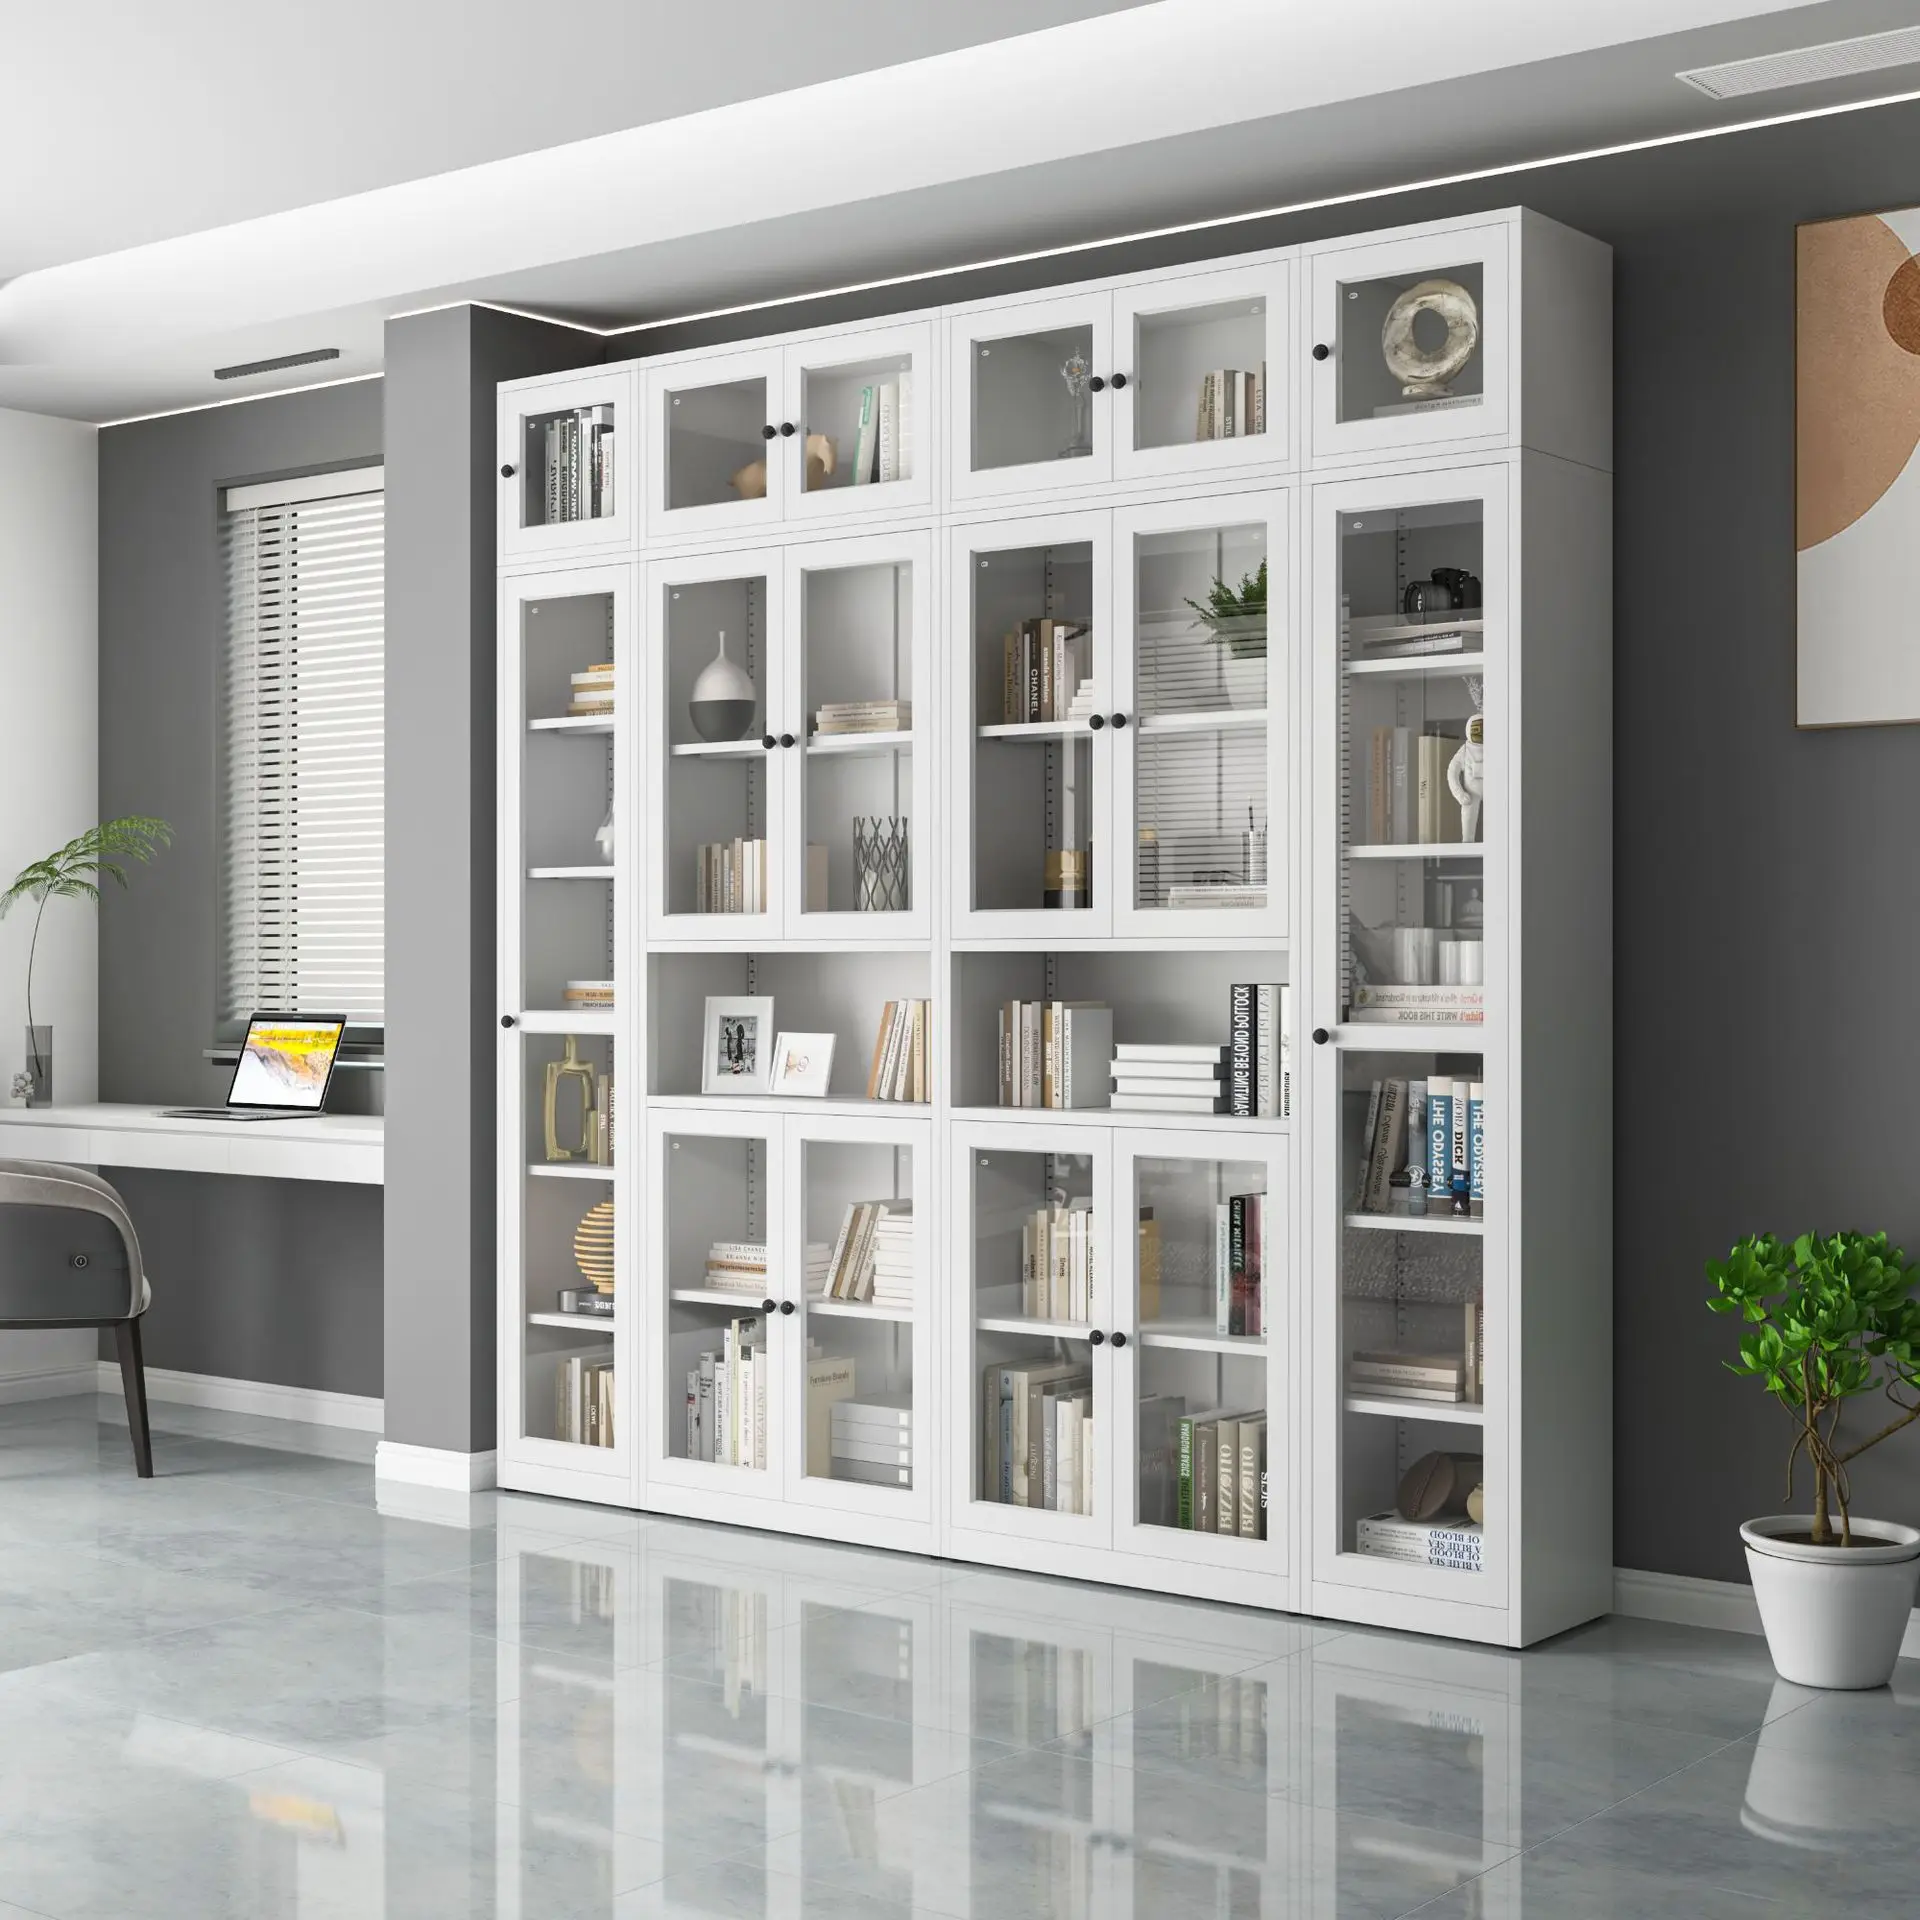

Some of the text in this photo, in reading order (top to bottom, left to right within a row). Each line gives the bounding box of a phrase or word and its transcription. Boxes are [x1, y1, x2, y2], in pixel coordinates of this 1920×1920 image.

[1219, 1444, 1232, 1529] BIZZOTTO
[1241, 1446, 1254, 1532] BIZZOTTO
[1430, 1530, 1480, 1544] OF BLOOD
[1428, 1539, 1482, 1553] A BLUE SEA
[1430, 1547, 1480, 1561] OF BLOOD
[1428, 1556, 1482, 1571] A BLUE SEA
